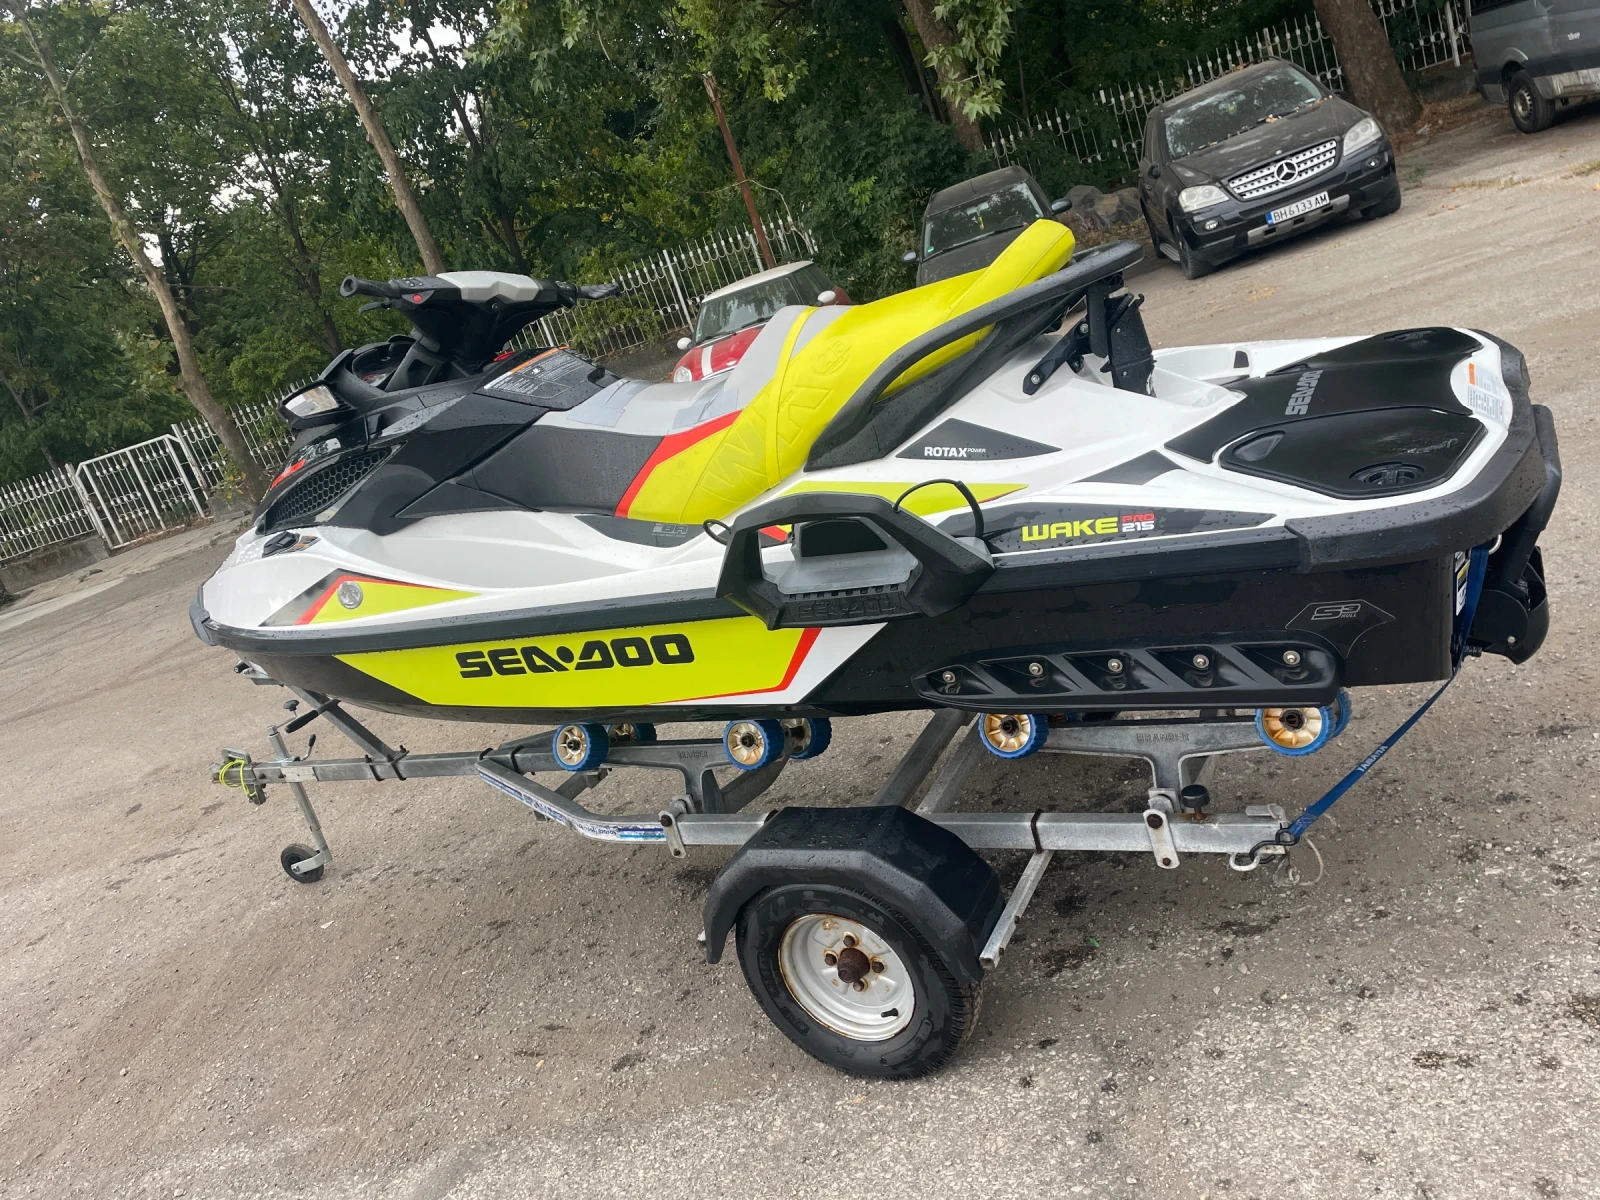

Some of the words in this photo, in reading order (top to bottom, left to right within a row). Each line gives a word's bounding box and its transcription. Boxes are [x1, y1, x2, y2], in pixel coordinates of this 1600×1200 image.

[1273, 209, 1288, 222] BH
[1289, 200, 1313, 216] 6133
[1315, 194, 1328, 207] AM
[924, 446, 968, 458] ROTAX
[1021, 516, 1119, 542] WAKE
[1121, 513, 1155, 523] PRO
[1121, 520, 1155, 533] 215
[1355, 745, 1388, 772] YAMAHA
